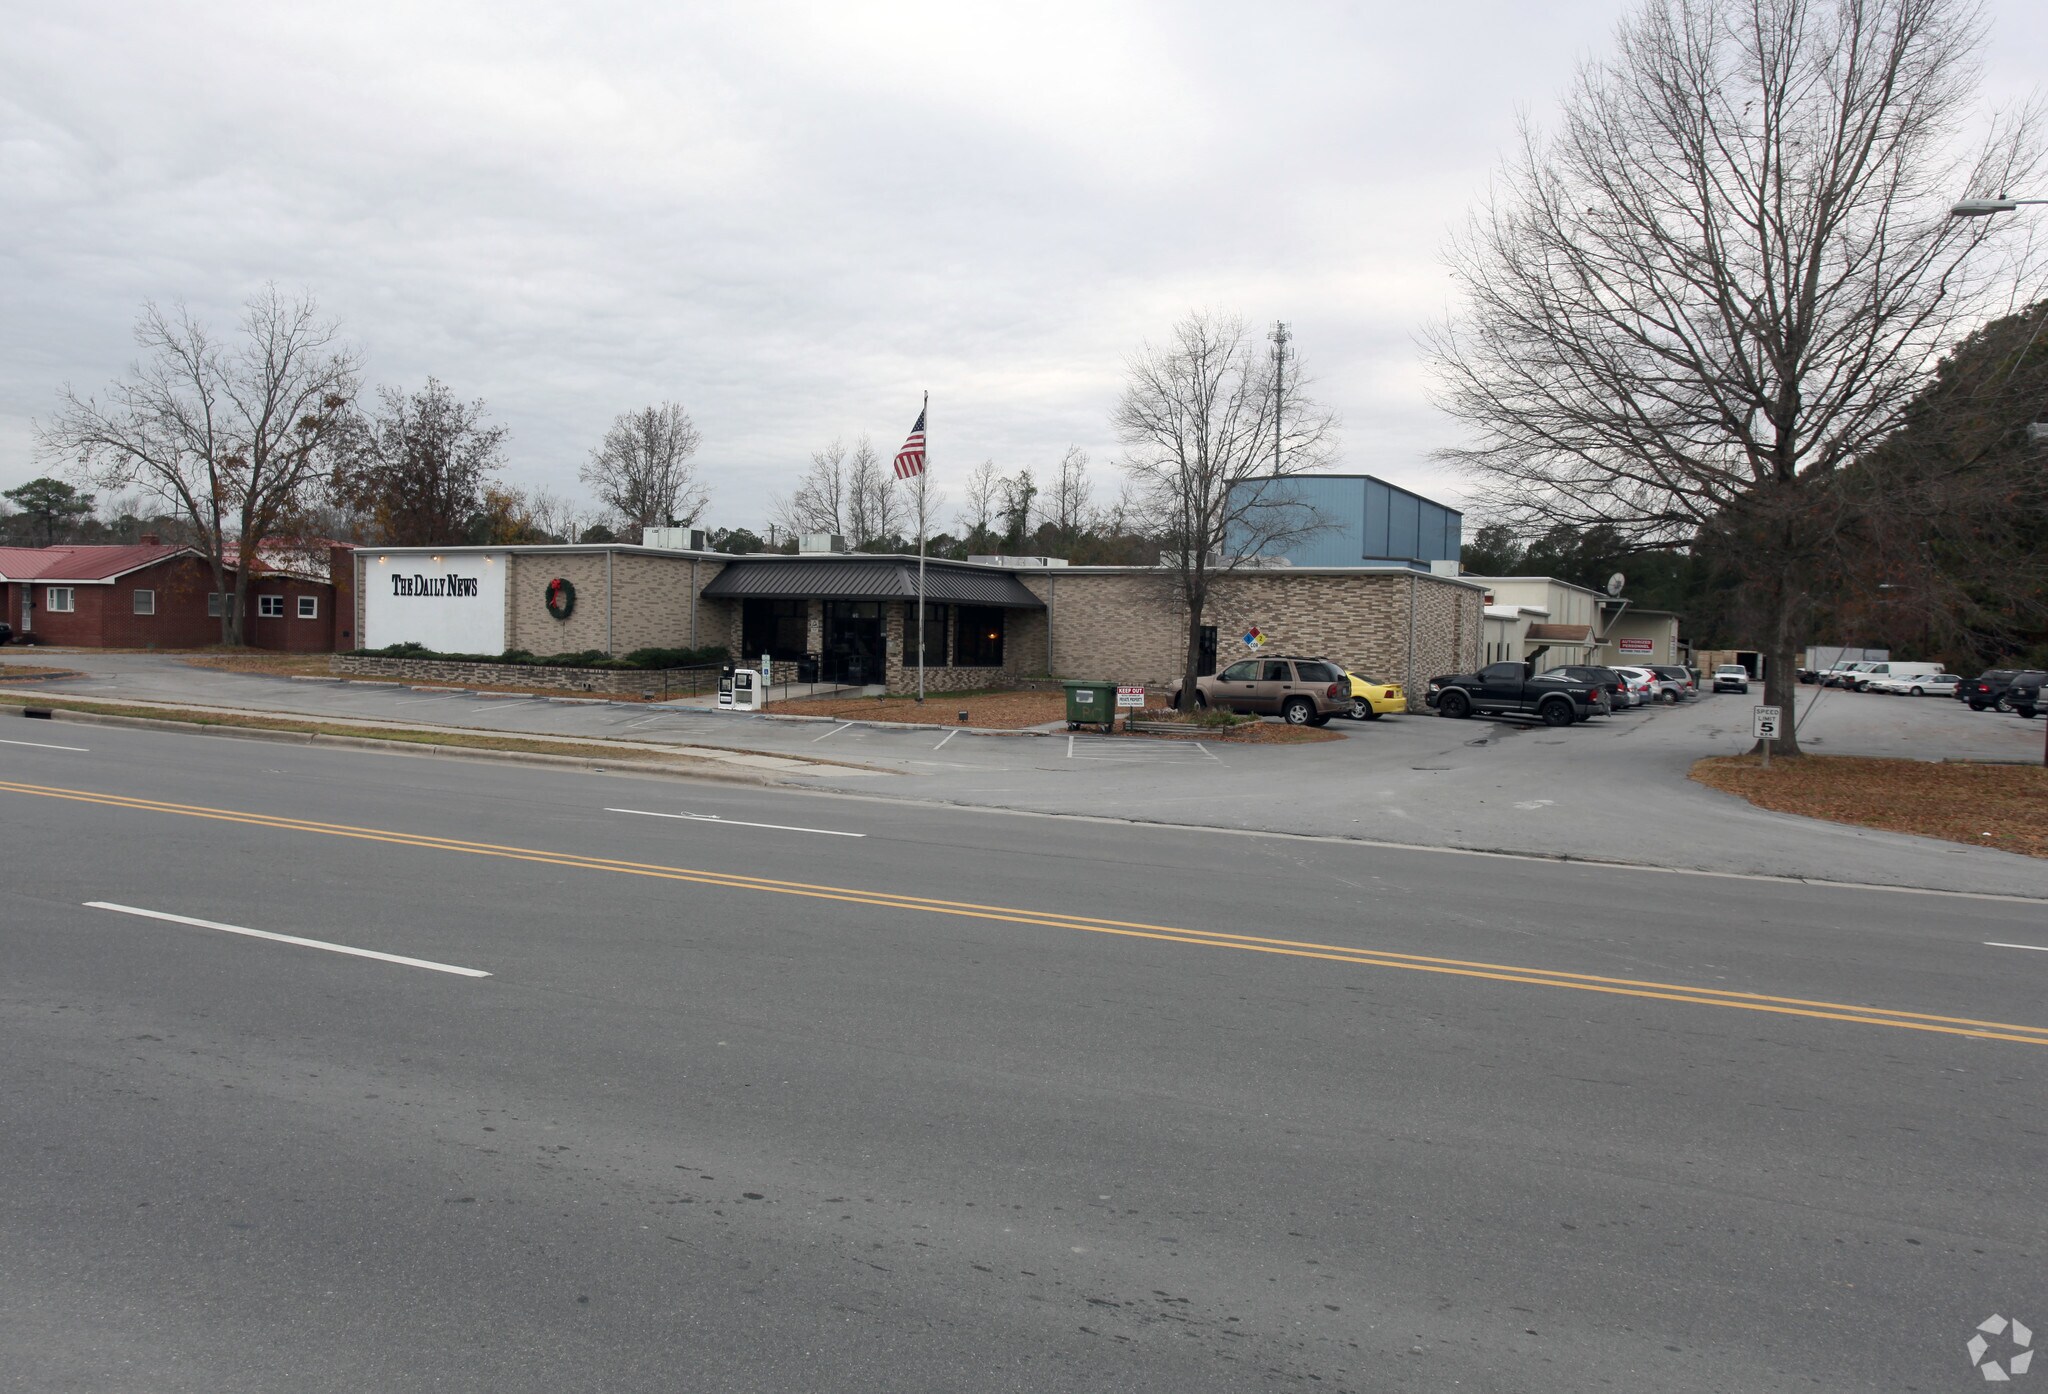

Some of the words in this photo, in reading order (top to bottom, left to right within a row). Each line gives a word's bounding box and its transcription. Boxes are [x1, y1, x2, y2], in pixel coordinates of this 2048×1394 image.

[392, 574, 413, 596] THE
[414, 574, 446, 597] DAILY
[446, 574, 478, 597] NEWS
[1760, 721, 1774, 732] 5
